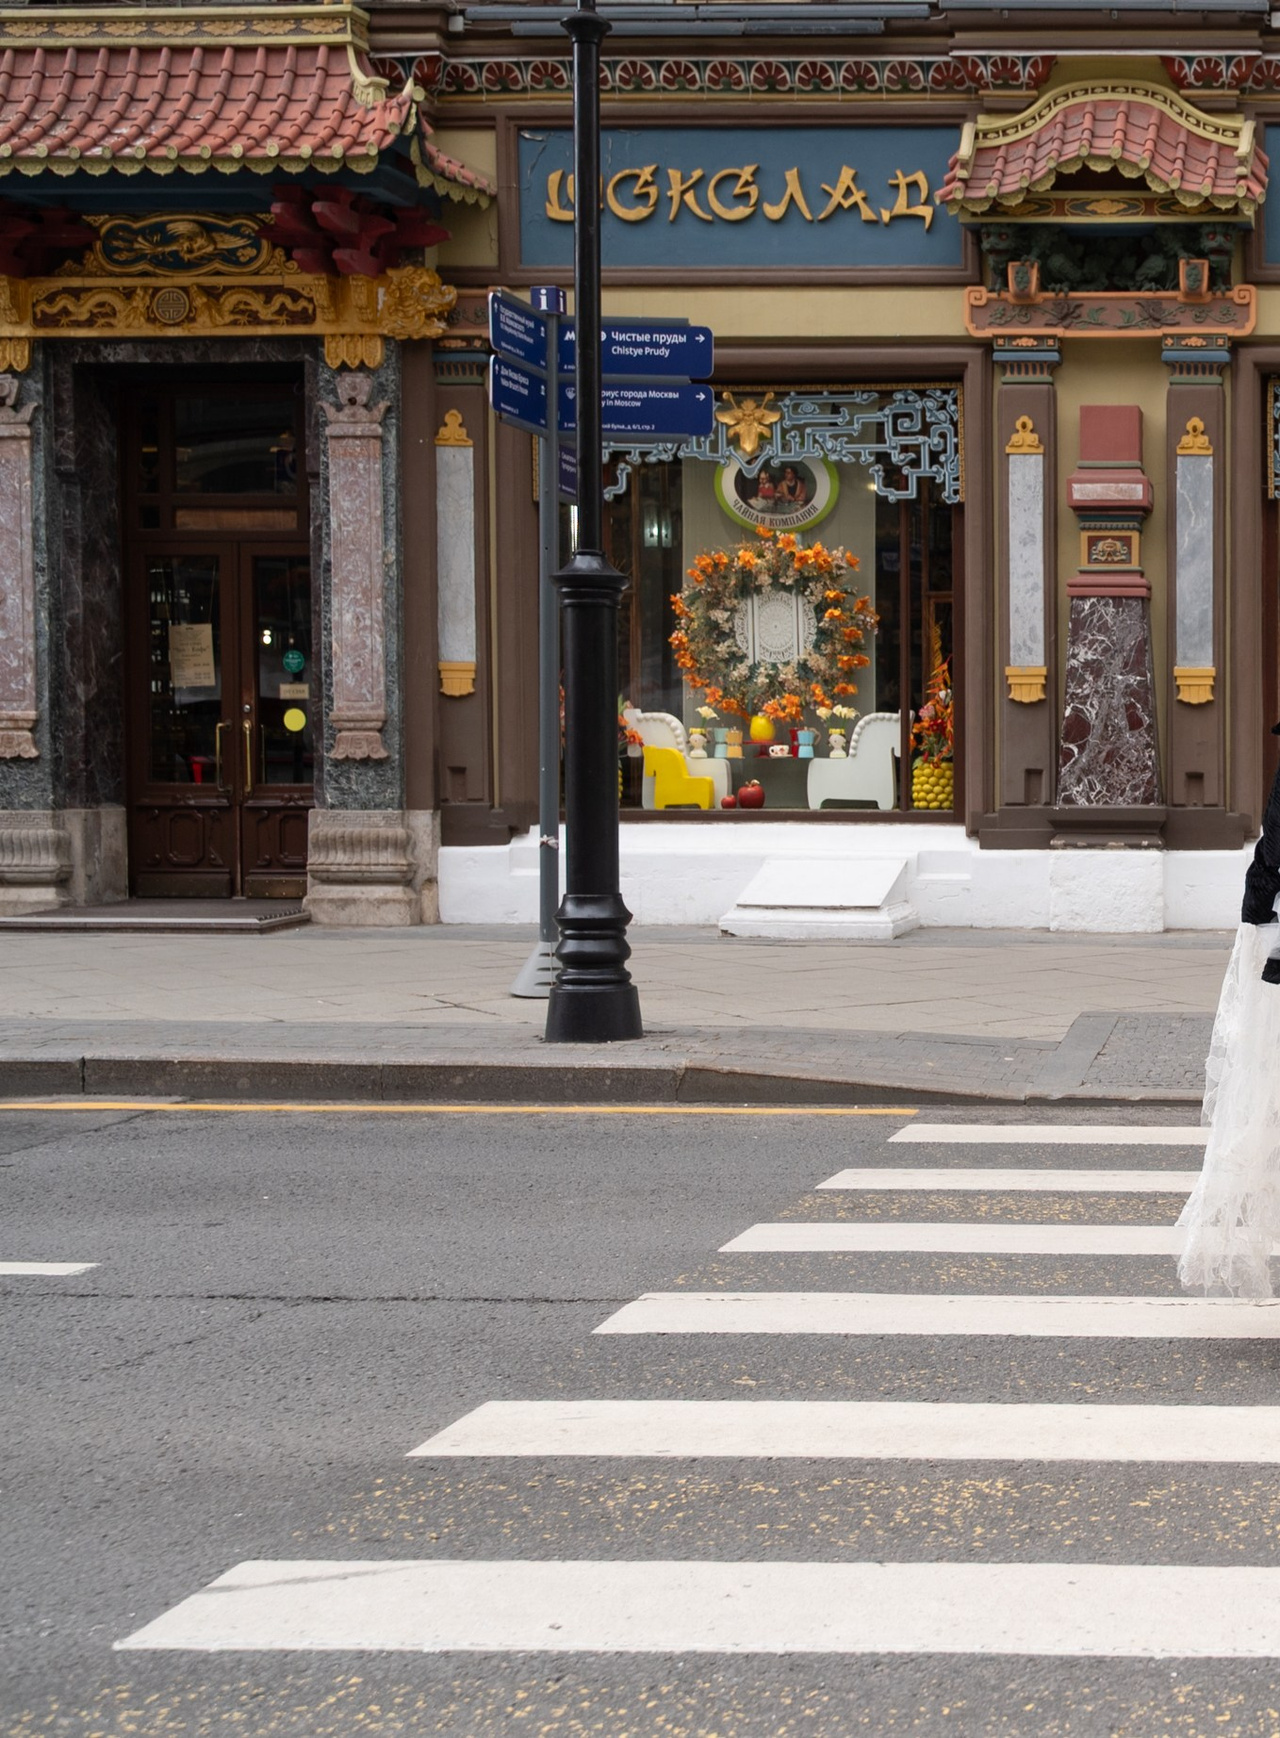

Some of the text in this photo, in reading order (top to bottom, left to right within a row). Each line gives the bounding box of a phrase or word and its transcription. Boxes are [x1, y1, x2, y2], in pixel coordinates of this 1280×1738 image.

[611, 331, 687, 345] Чистые пруды
[611, 346, 671, 358] Chistye Prudy
[620, 391, 647, 400] города
[648, 390, 680, 399] Москвы
[733, 498, 819, 527] ЧАЙНАЯ КОМПАНИЯ
